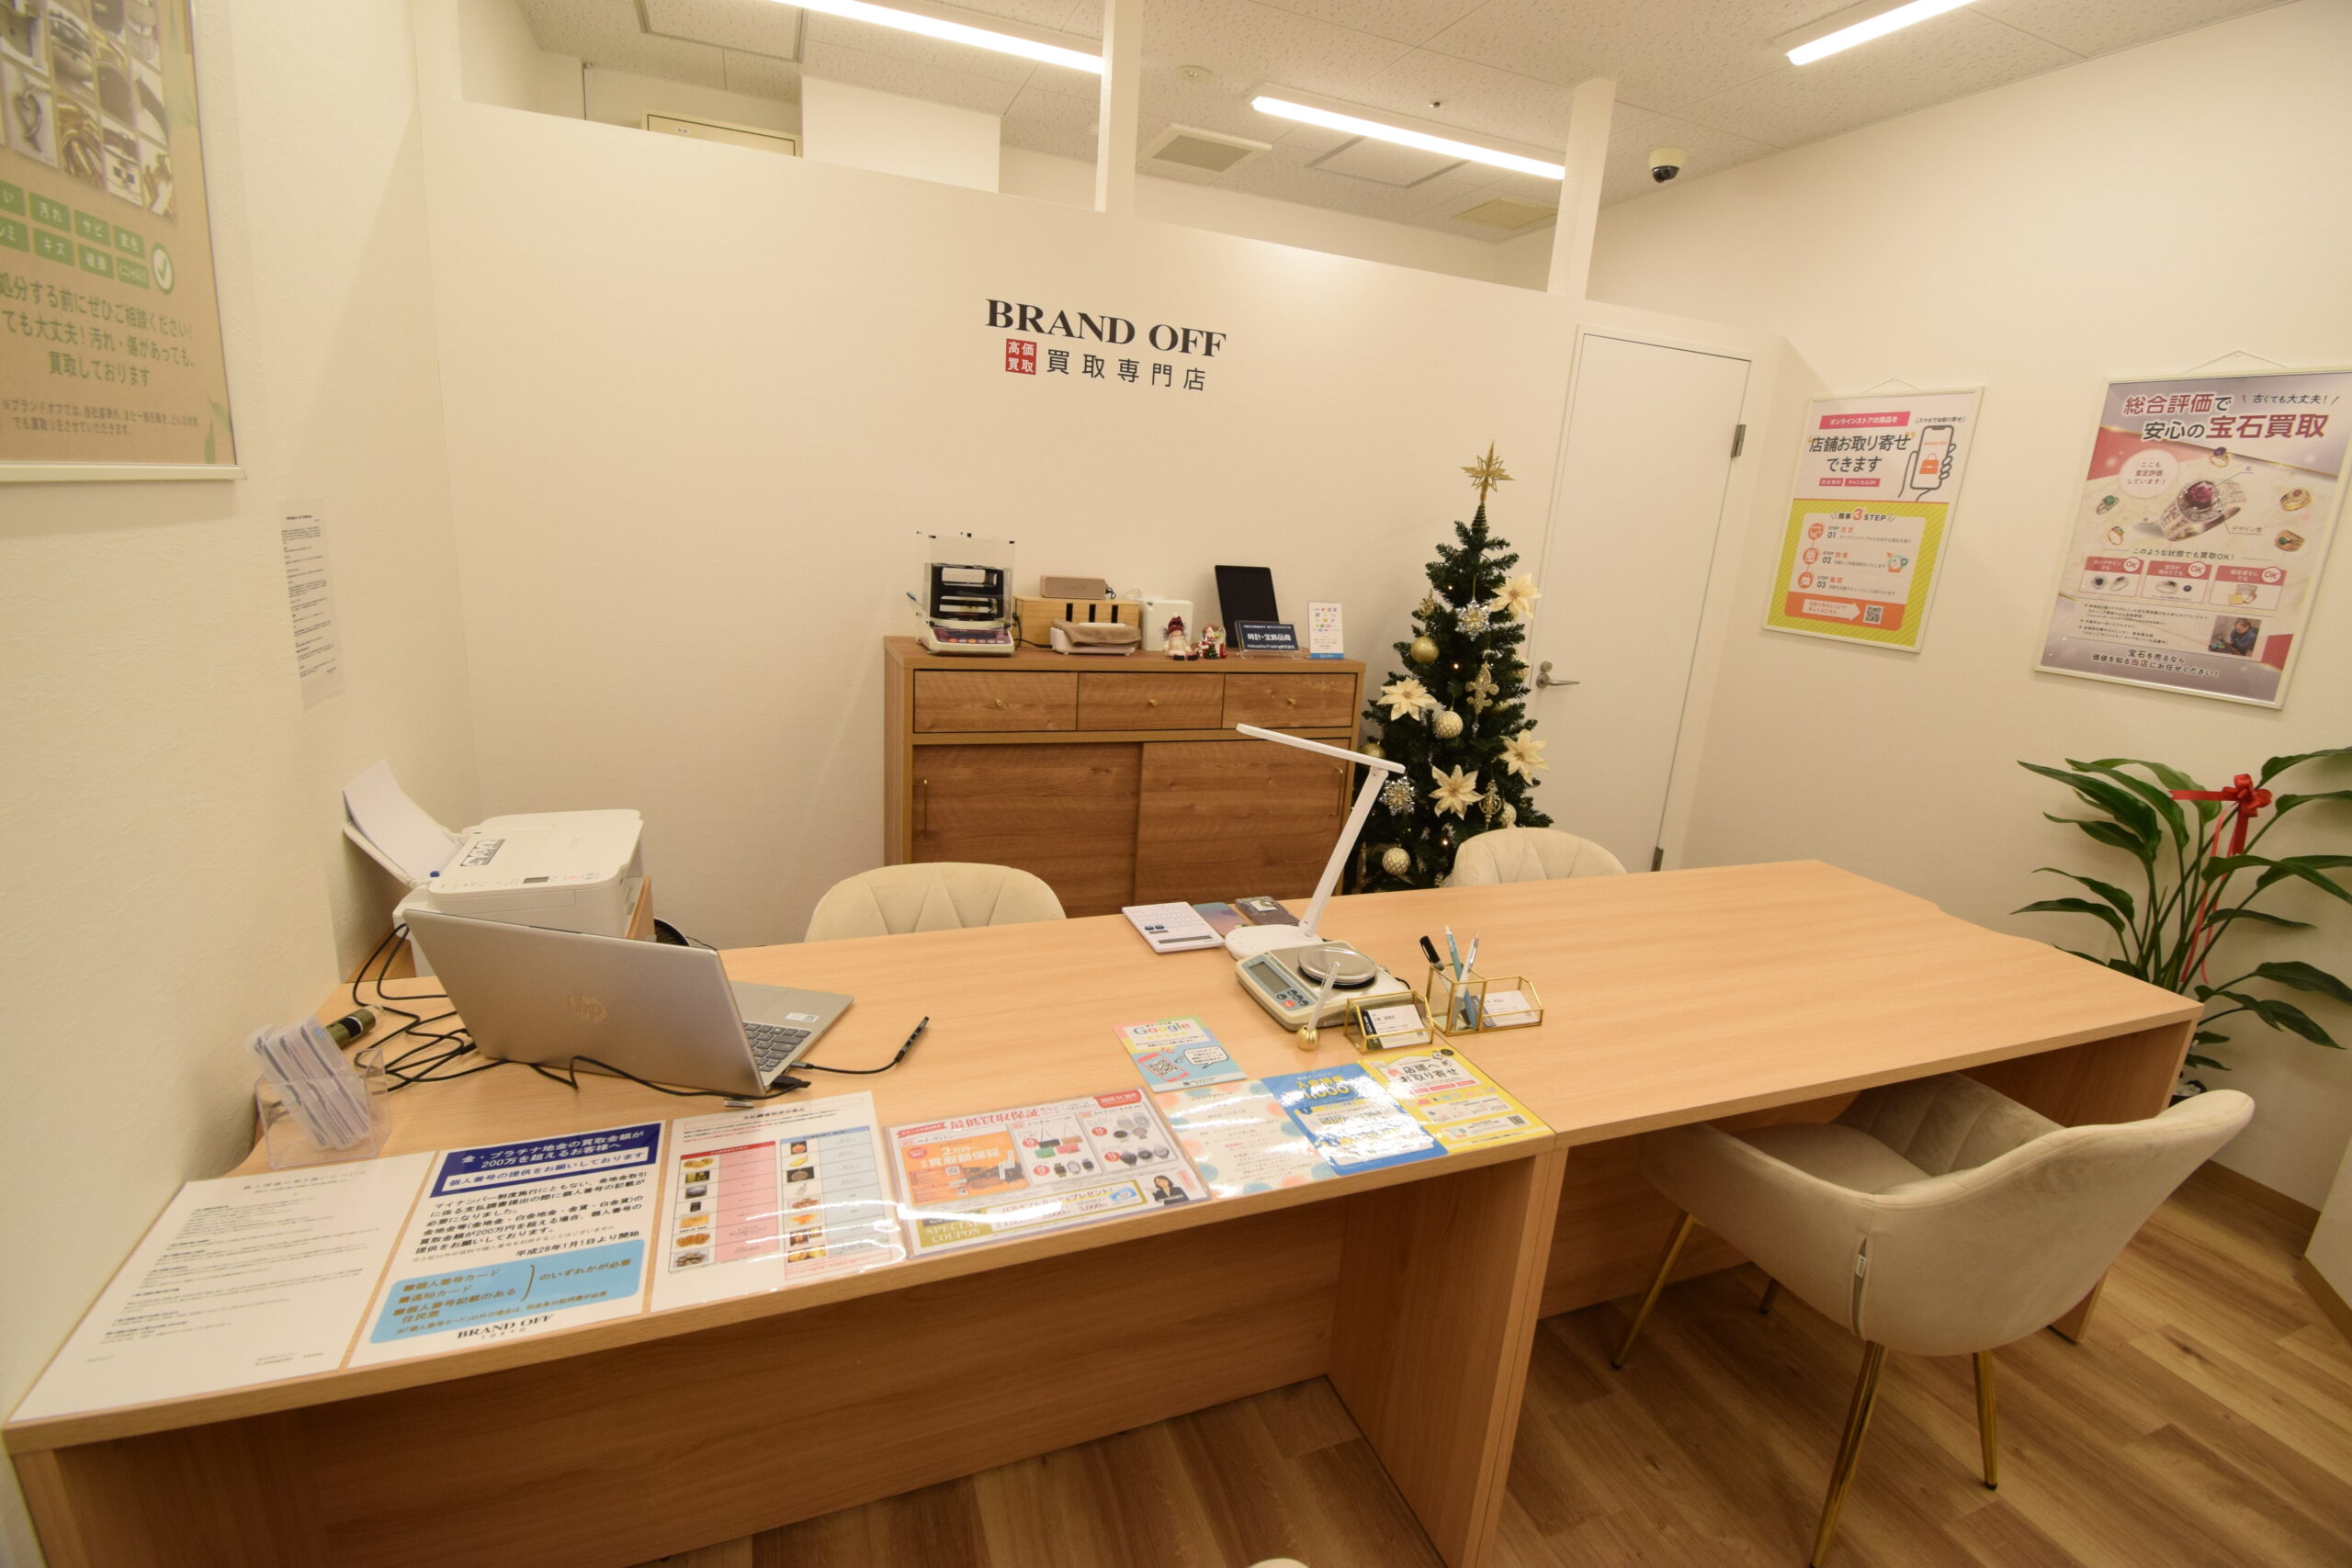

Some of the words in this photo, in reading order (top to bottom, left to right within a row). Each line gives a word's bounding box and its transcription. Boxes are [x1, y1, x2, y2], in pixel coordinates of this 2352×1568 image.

[985, 299, 1136, 345] BRAND
[1148, 323, 1227, 358] OFF
[1007, 341, 1035, 357] 高価
[1007, 356, 1035, 374] 買取
[1046, 348, 1206, 392] 買取専門店
[2123, 393, 2233, 415] 総合評価で
[2143, 413, 2330, 441] 安心の宝石買取
[1826, 456, 1883, 473] できます
[1852, 508, 1863, 521] 3
[1864, 513, 1887, 522] STEP
[1827, 531, 1837, 539] 01
[2125, 560, 2138, 569] OK
[2189, 565, 2204, 574] OK
[2264, 570, 2278, 580] OK
[1816, 581, 1826, 589] 03
[1133, 1022, 1192, 1035] Google
[460, 1130, 644, 1164] 金・プラチナ地金の買取金額が
[480, 1142, 622, 1169] 200万を超えるお客様へ
[456, 1321, 516, 1338] BRAND
[519, 1314, 554, 1326] OFF
